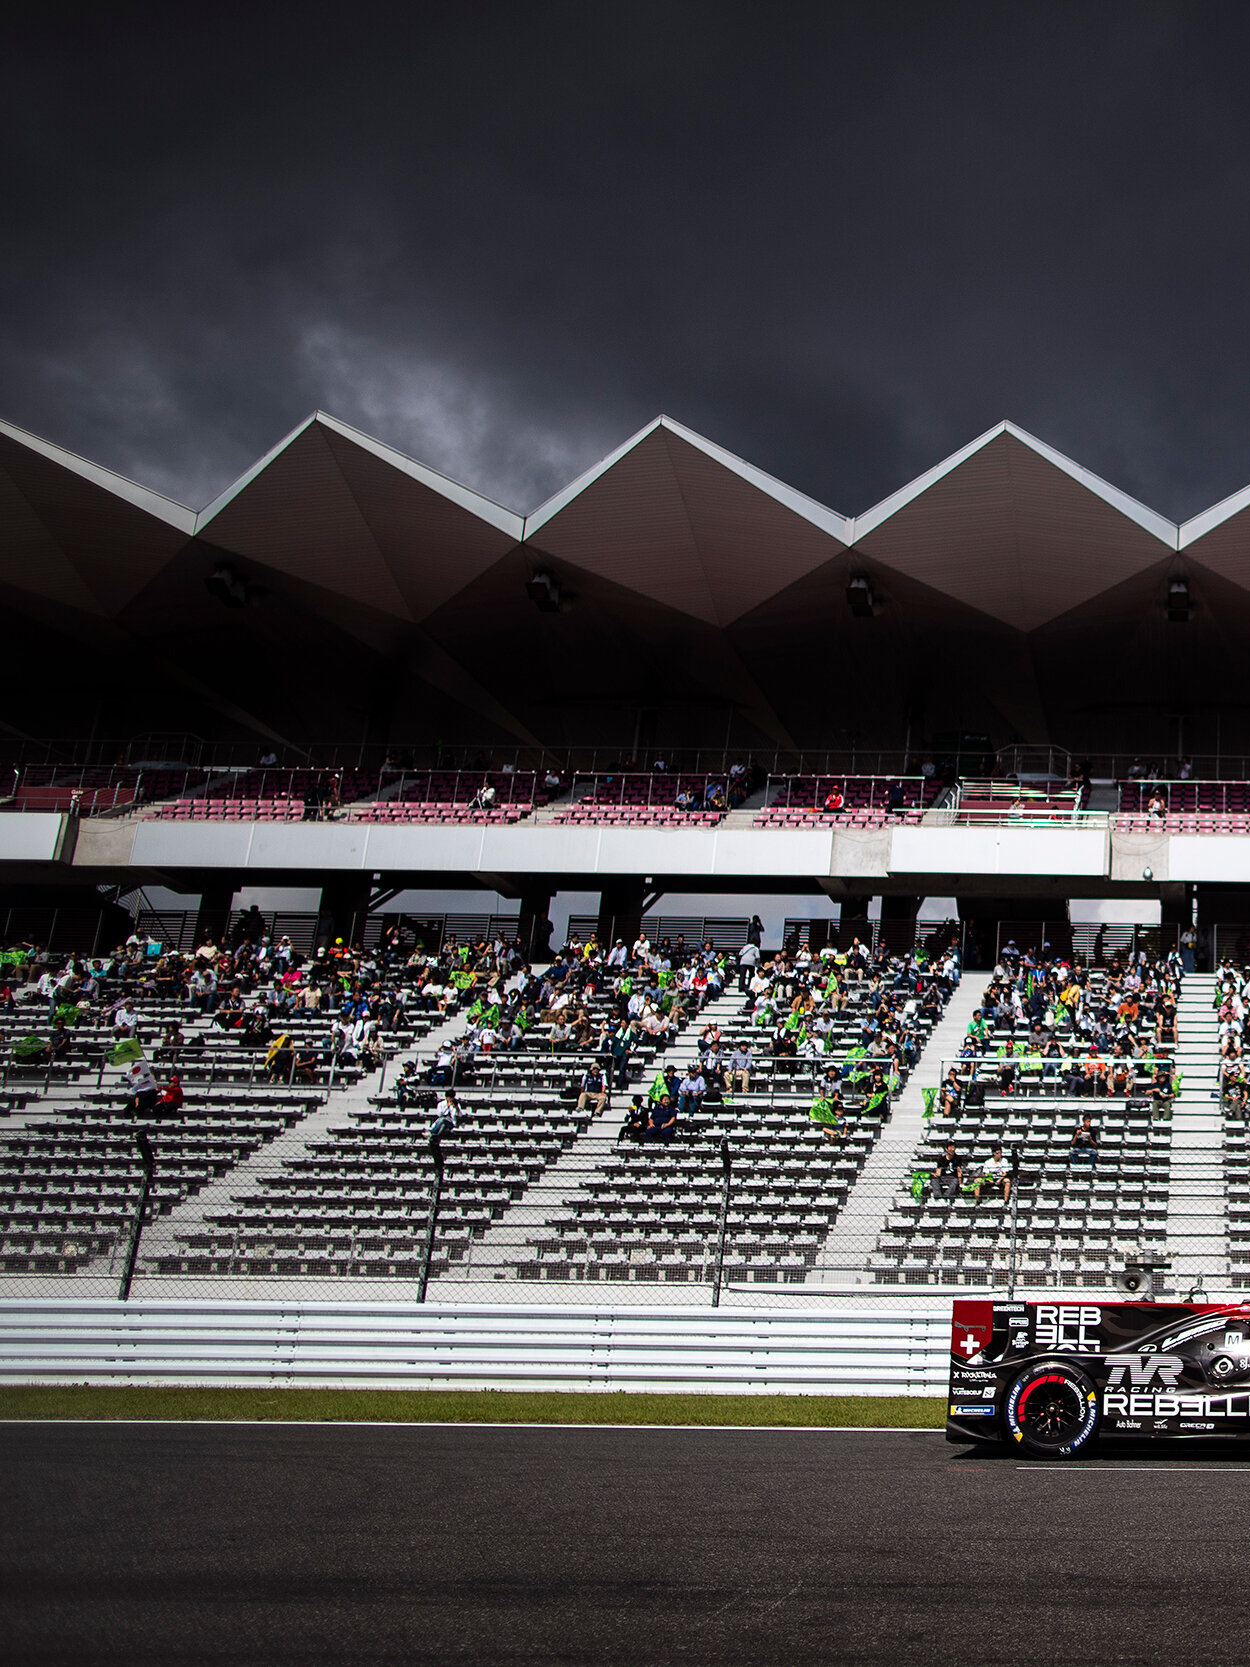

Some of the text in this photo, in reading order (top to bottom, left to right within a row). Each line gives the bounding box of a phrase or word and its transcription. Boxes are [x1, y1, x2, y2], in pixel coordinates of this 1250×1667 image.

[1036, 1305, 1102, 1326] REB
[1227, 1335, 1240, 1345] M
[1103, 1354, 1184, 1385] TVR
[1008, 1384, 1021, 1427] MICHELIN
[1063, 1378, 1086, 1422] REBELLION
[1073, 1408, 1097, 1447] MICHELIN
